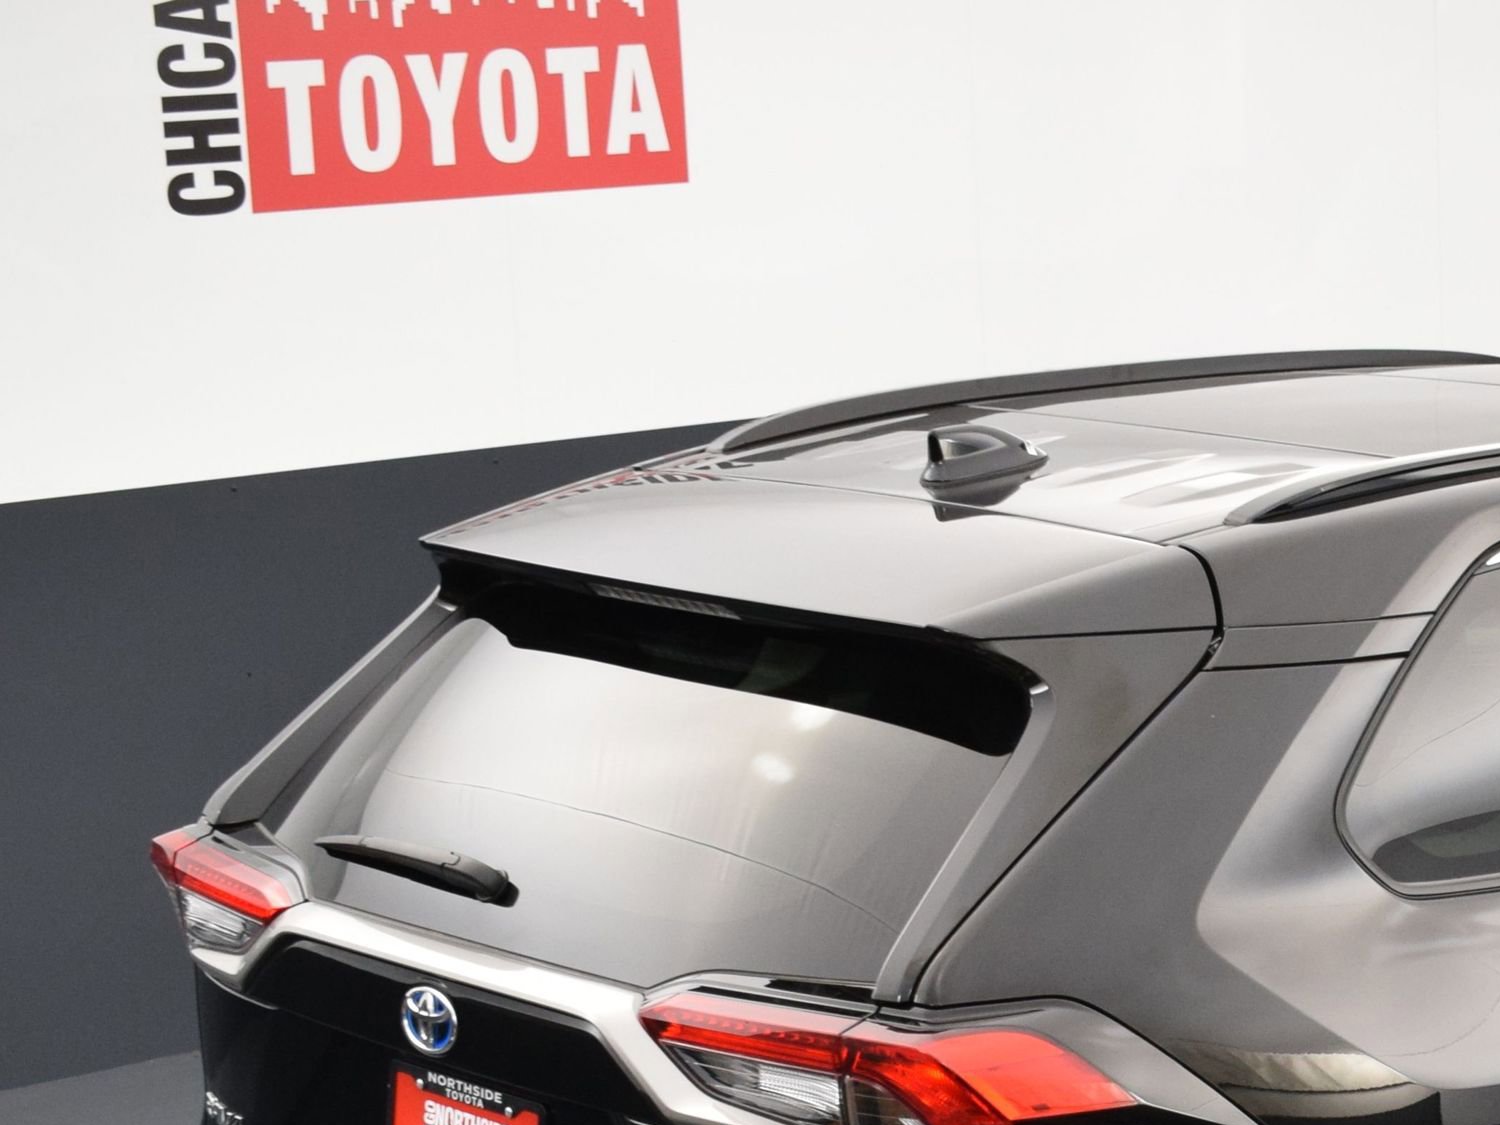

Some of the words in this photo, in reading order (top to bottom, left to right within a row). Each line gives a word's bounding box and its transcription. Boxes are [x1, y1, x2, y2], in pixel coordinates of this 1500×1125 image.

[153, 0, 246, 216] CHICA
[265, 44, 670, 176] TOYOTA
[427, 1071, 503, 1104] NORTHSIDE
[445, 1088, 484, 1109] TOYOTA
